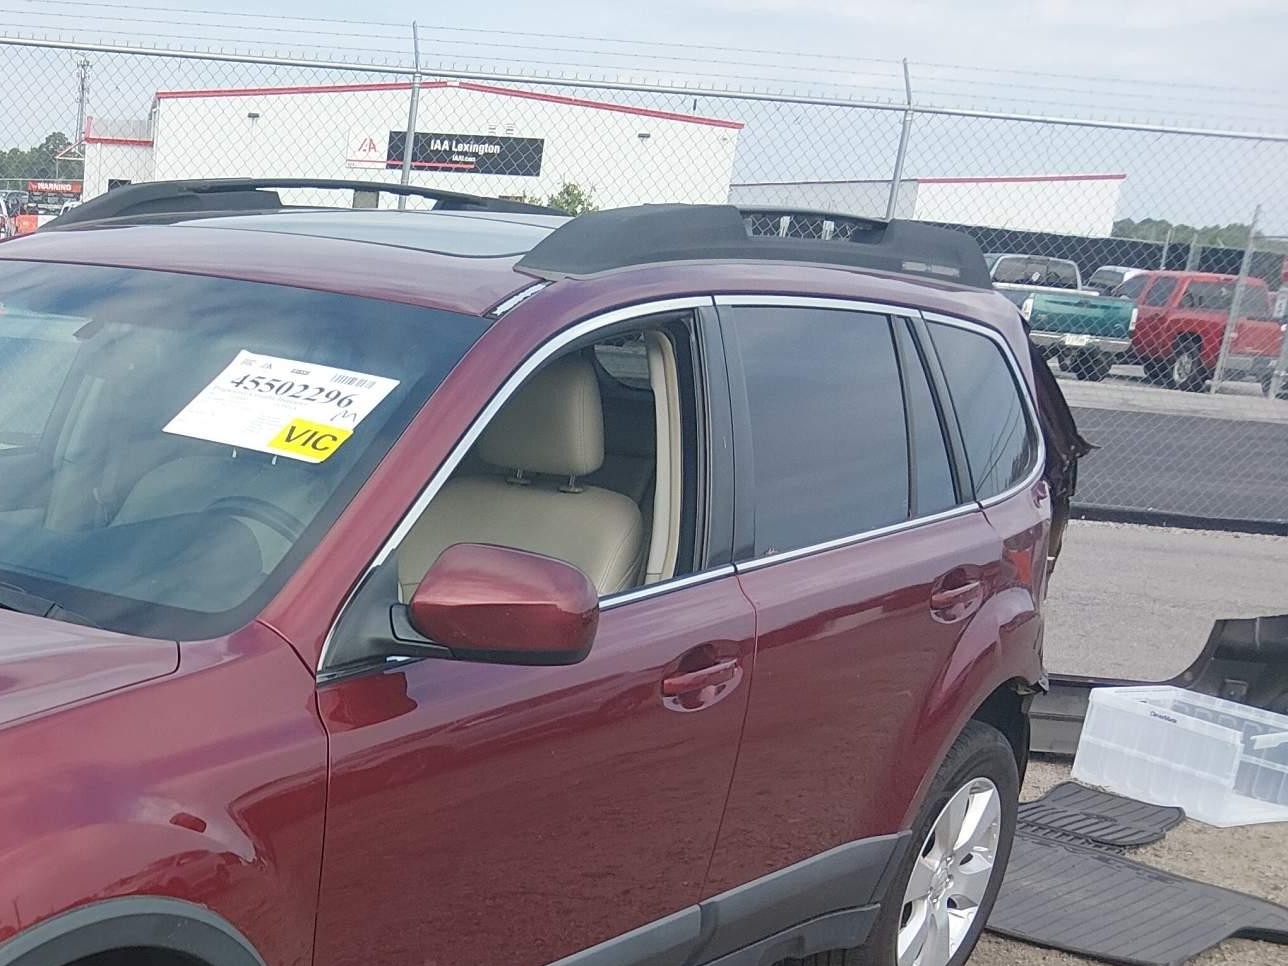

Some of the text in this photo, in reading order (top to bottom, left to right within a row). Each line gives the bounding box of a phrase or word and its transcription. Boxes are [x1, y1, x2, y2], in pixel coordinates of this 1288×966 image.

[430, 139, 501, 155] IAA Lexington
[37, 182, 72, 191] WARNING
[230, 374, 360, 408] 45502296
[285, 425, 338, 451] VIC
